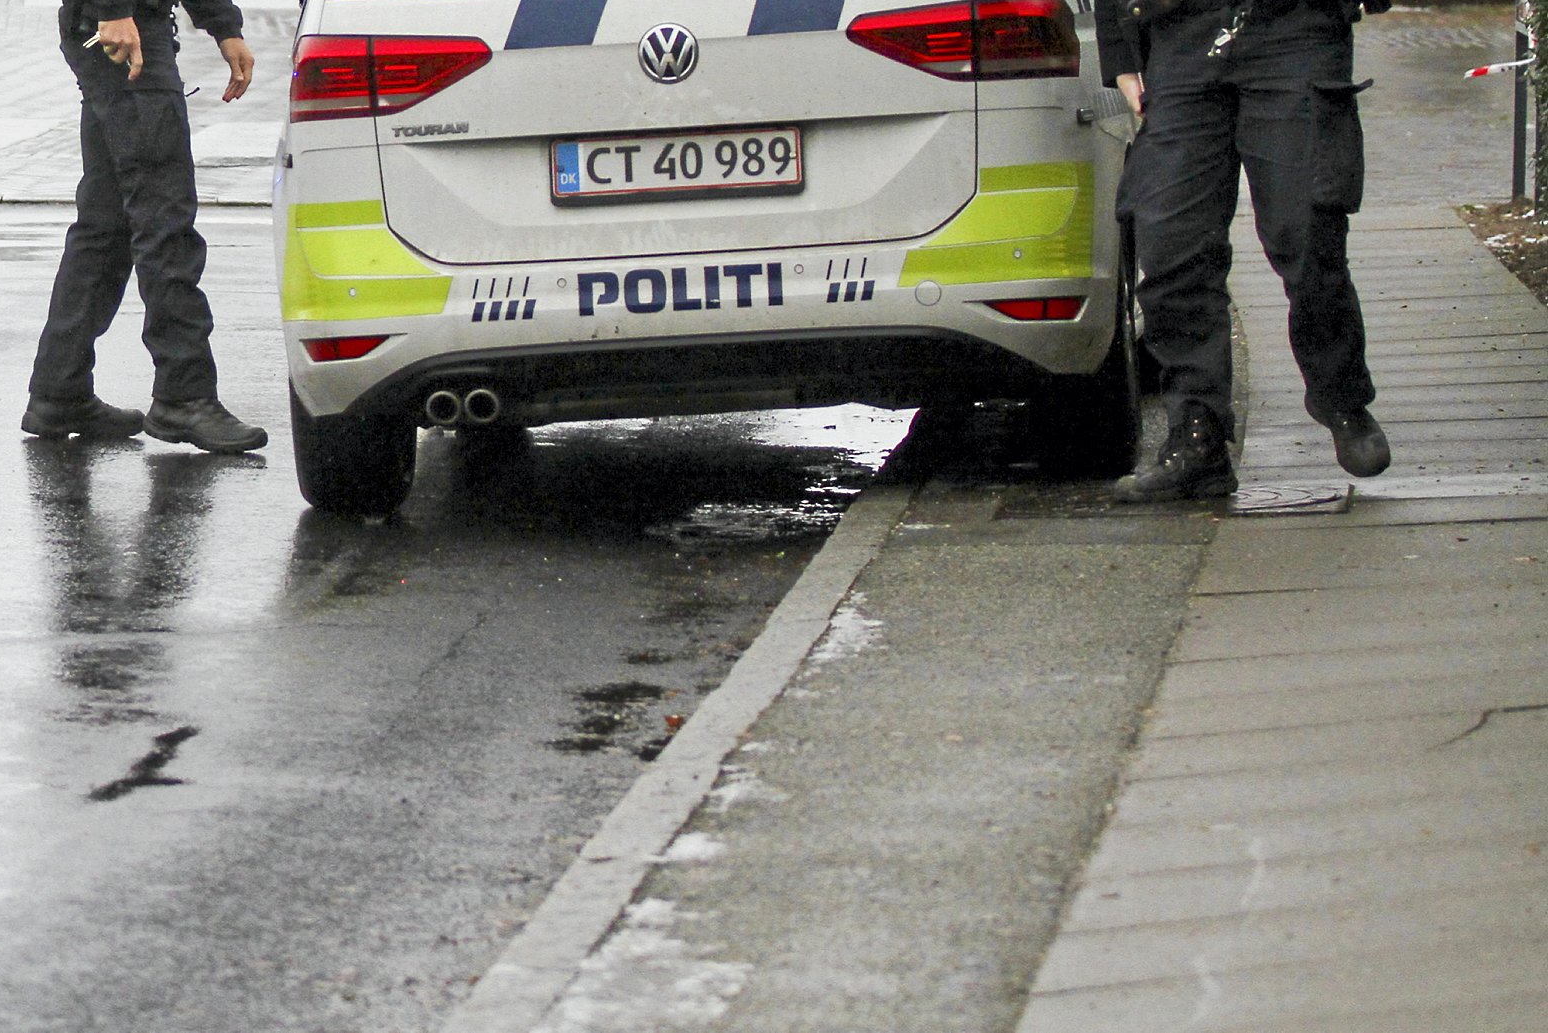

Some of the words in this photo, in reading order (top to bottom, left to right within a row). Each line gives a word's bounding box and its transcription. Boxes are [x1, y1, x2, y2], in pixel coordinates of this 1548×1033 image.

[391, 122, 470, 138] TOURAN
[586, 146, 641, 185] CT
[653, 141, 703, 181] 40
[715, 136, 792, 179] 989
[560, 172, 578, 185] DK
[577, 262, 783, 317] POLITI
